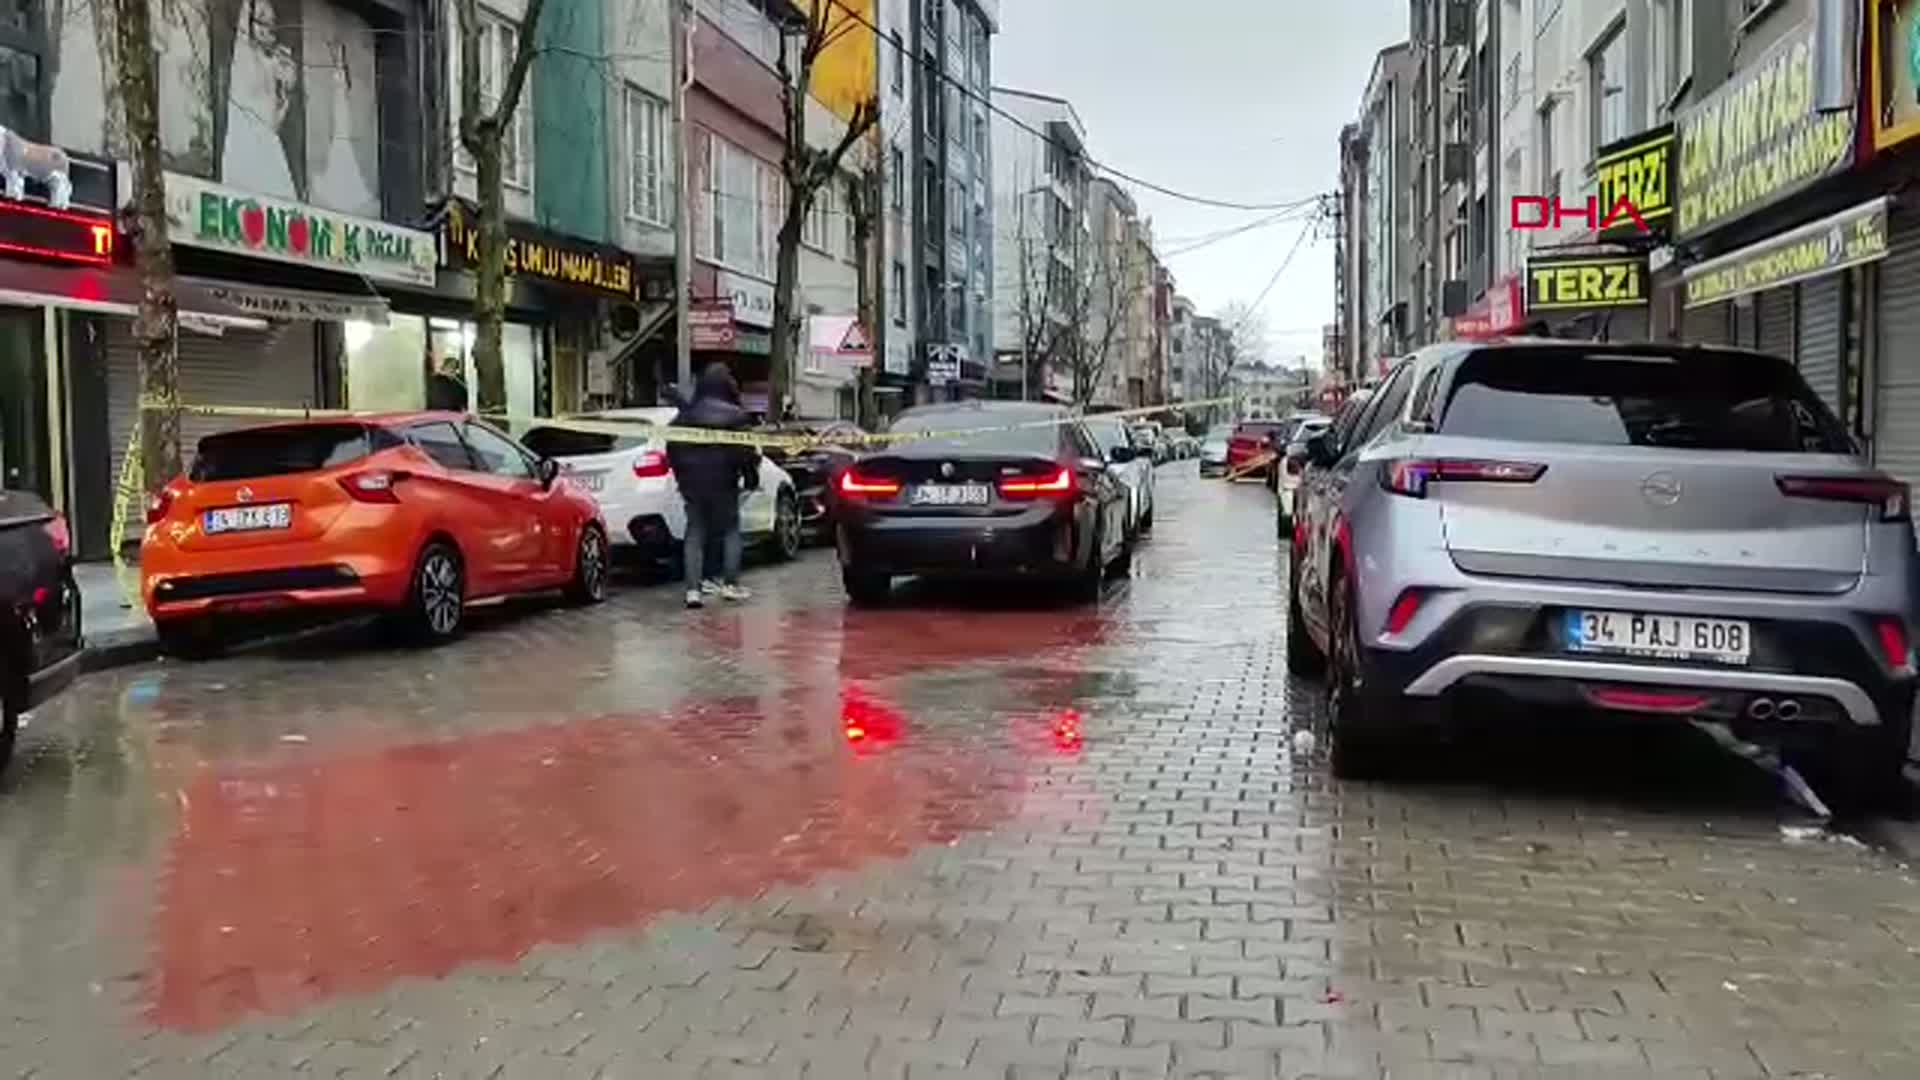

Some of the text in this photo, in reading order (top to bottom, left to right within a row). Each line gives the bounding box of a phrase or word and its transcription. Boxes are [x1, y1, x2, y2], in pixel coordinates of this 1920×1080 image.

[1532, 263, 1640, 302] TERZi
[1584, 614, 1744, 652] 34 PAJ 608
